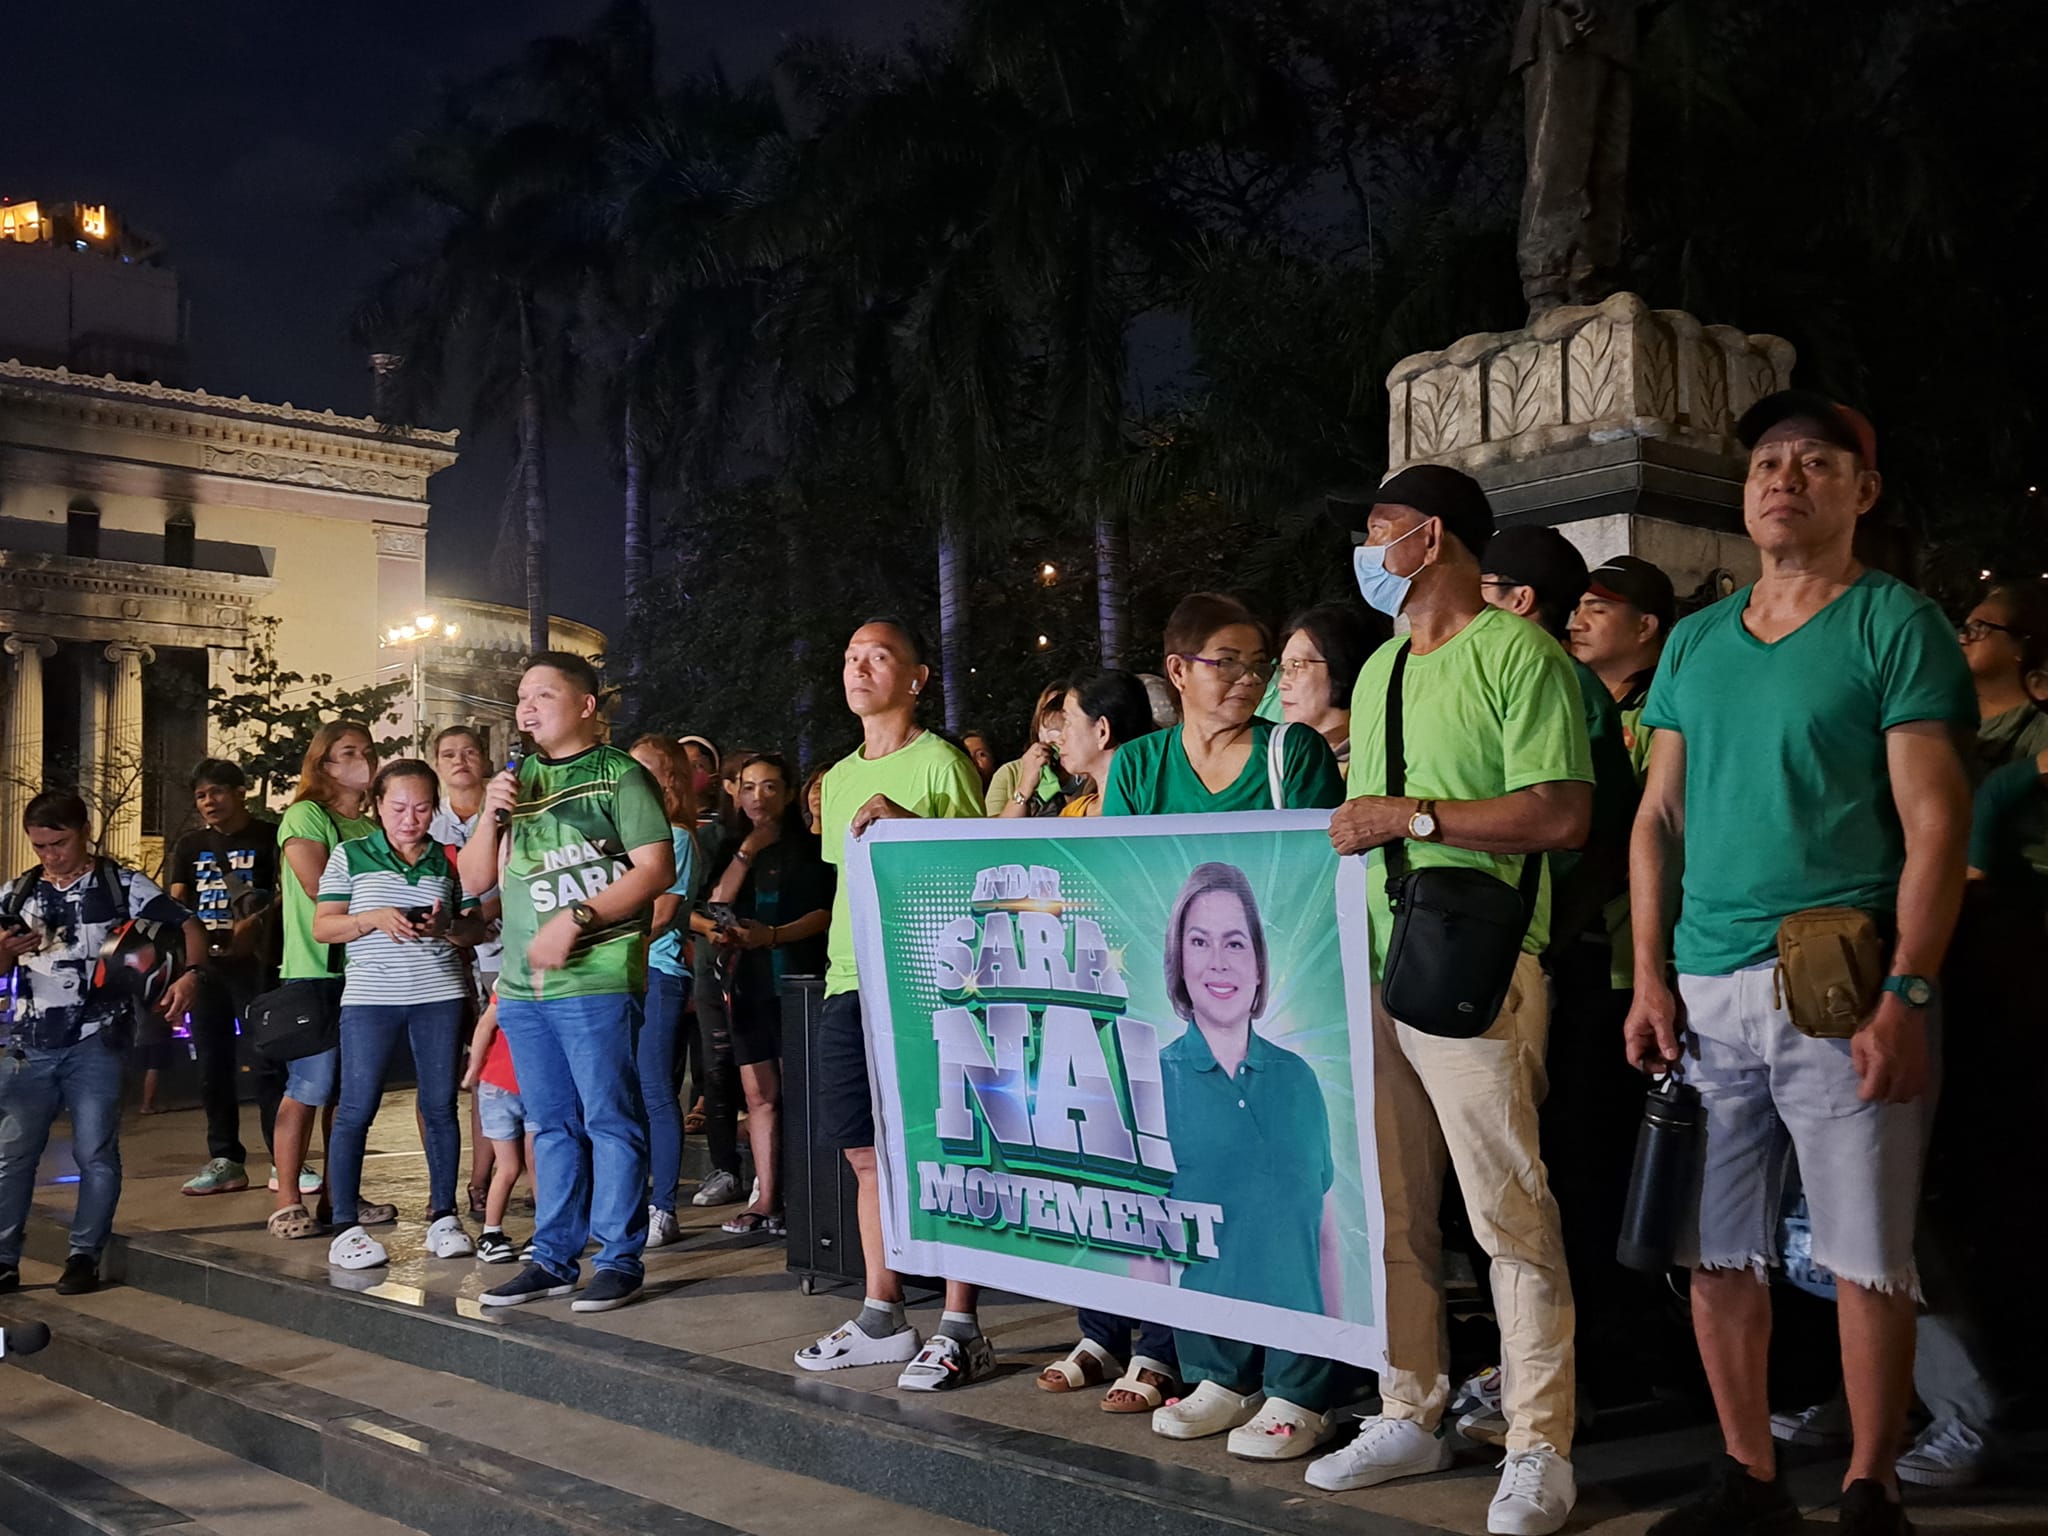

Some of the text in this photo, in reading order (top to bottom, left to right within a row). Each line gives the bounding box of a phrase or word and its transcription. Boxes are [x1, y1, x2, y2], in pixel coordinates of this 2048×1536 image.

[543, 839, 607, 871] INDAY
[936, 912, 1129, 999] SARA
[932, 1002, 1178, 1174] NA!
[917, 1160, 1224, 1260] MOVEMENT
